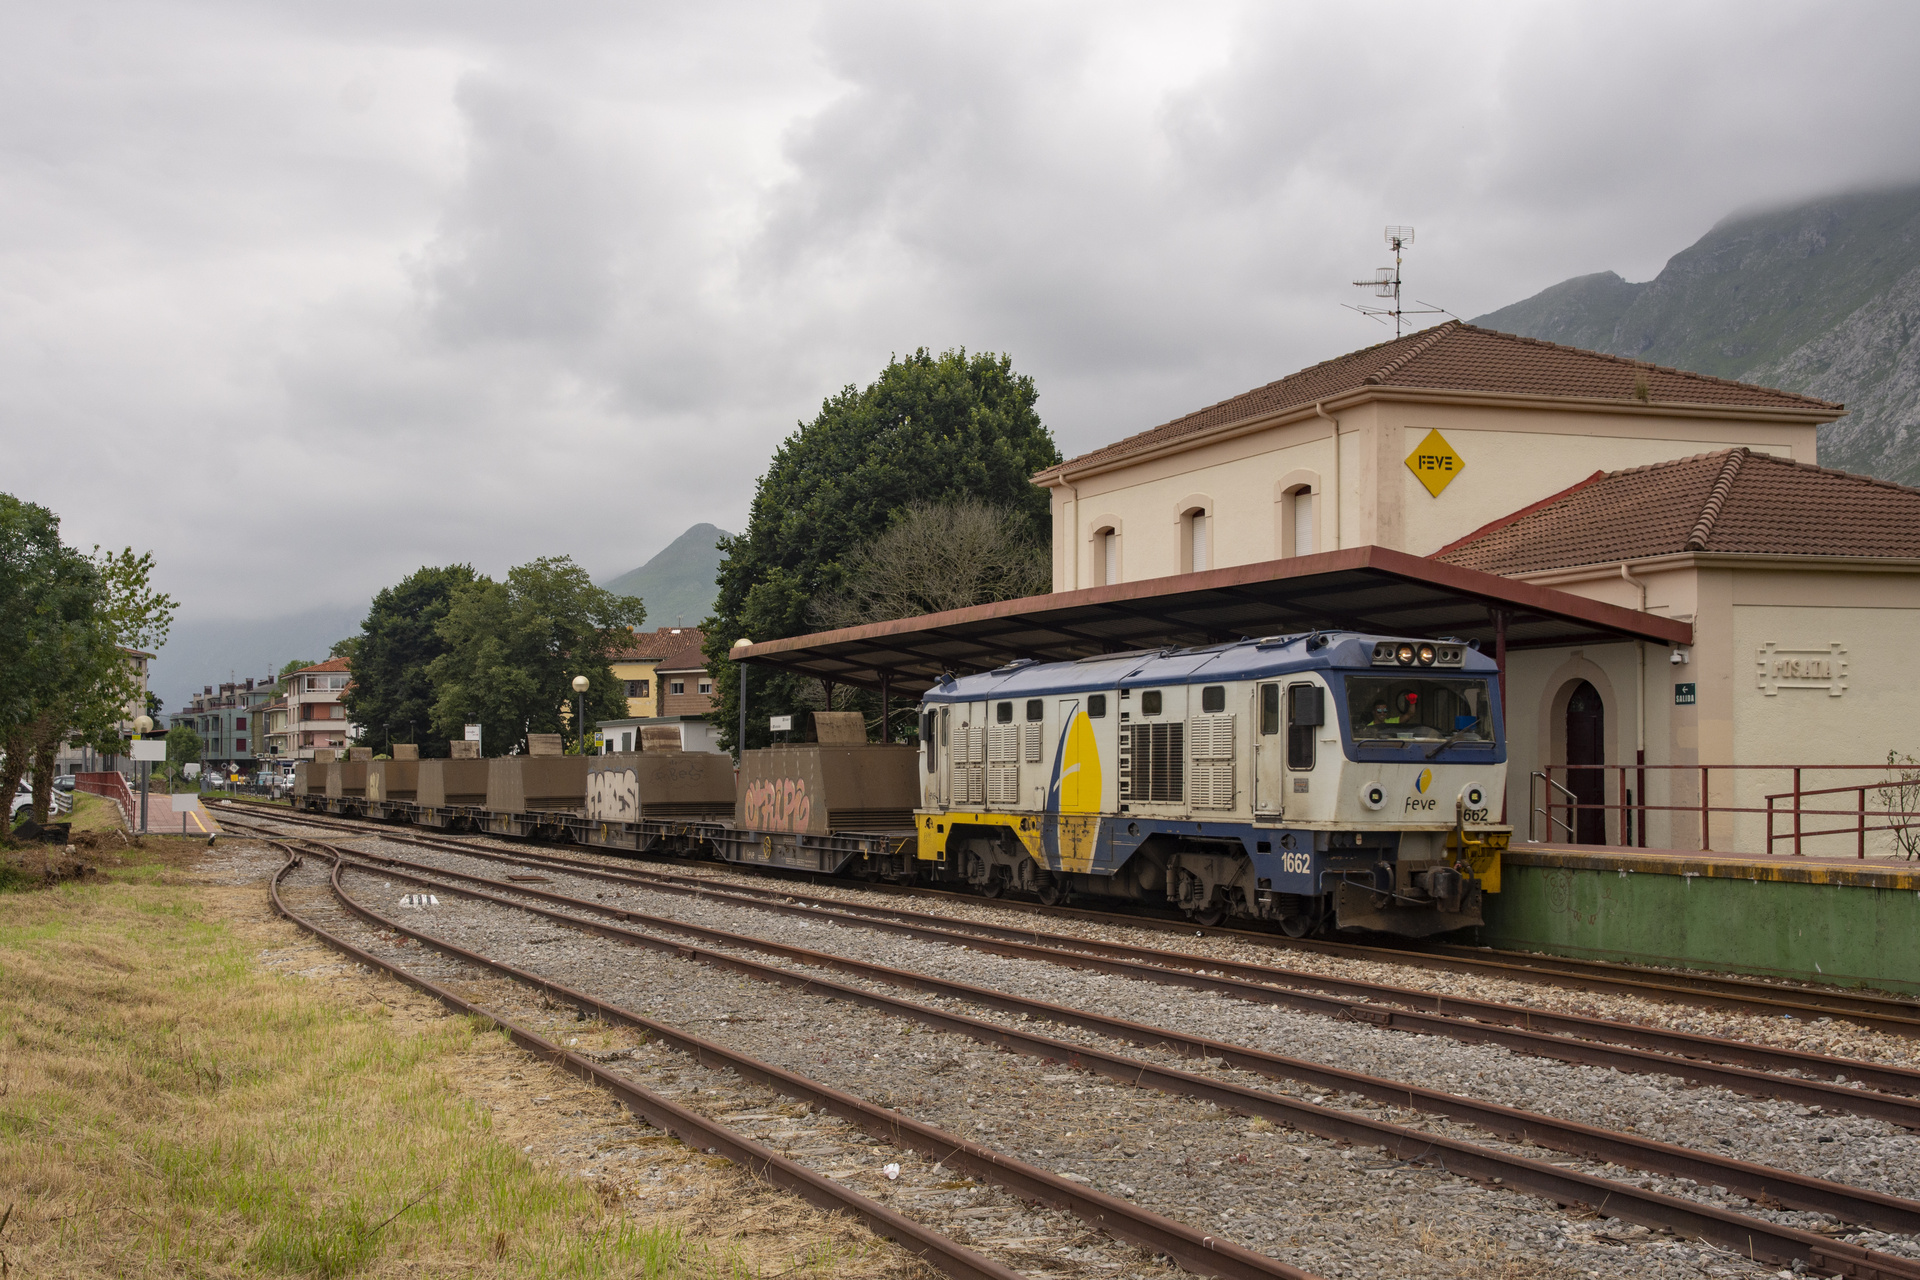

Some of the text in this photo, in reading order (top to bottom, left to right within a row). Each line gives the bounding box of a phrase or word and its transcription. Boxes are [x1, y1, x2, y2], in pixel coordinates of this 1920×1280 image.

[1419, 455, 1452, 470] FEVE
[1676, 695, 1694, 703] SALIDA
[1405, 797, 1436, 813] feve
[1463, 808, 1488, 821] 662
[1281, 852, 1310, 874] 1662
